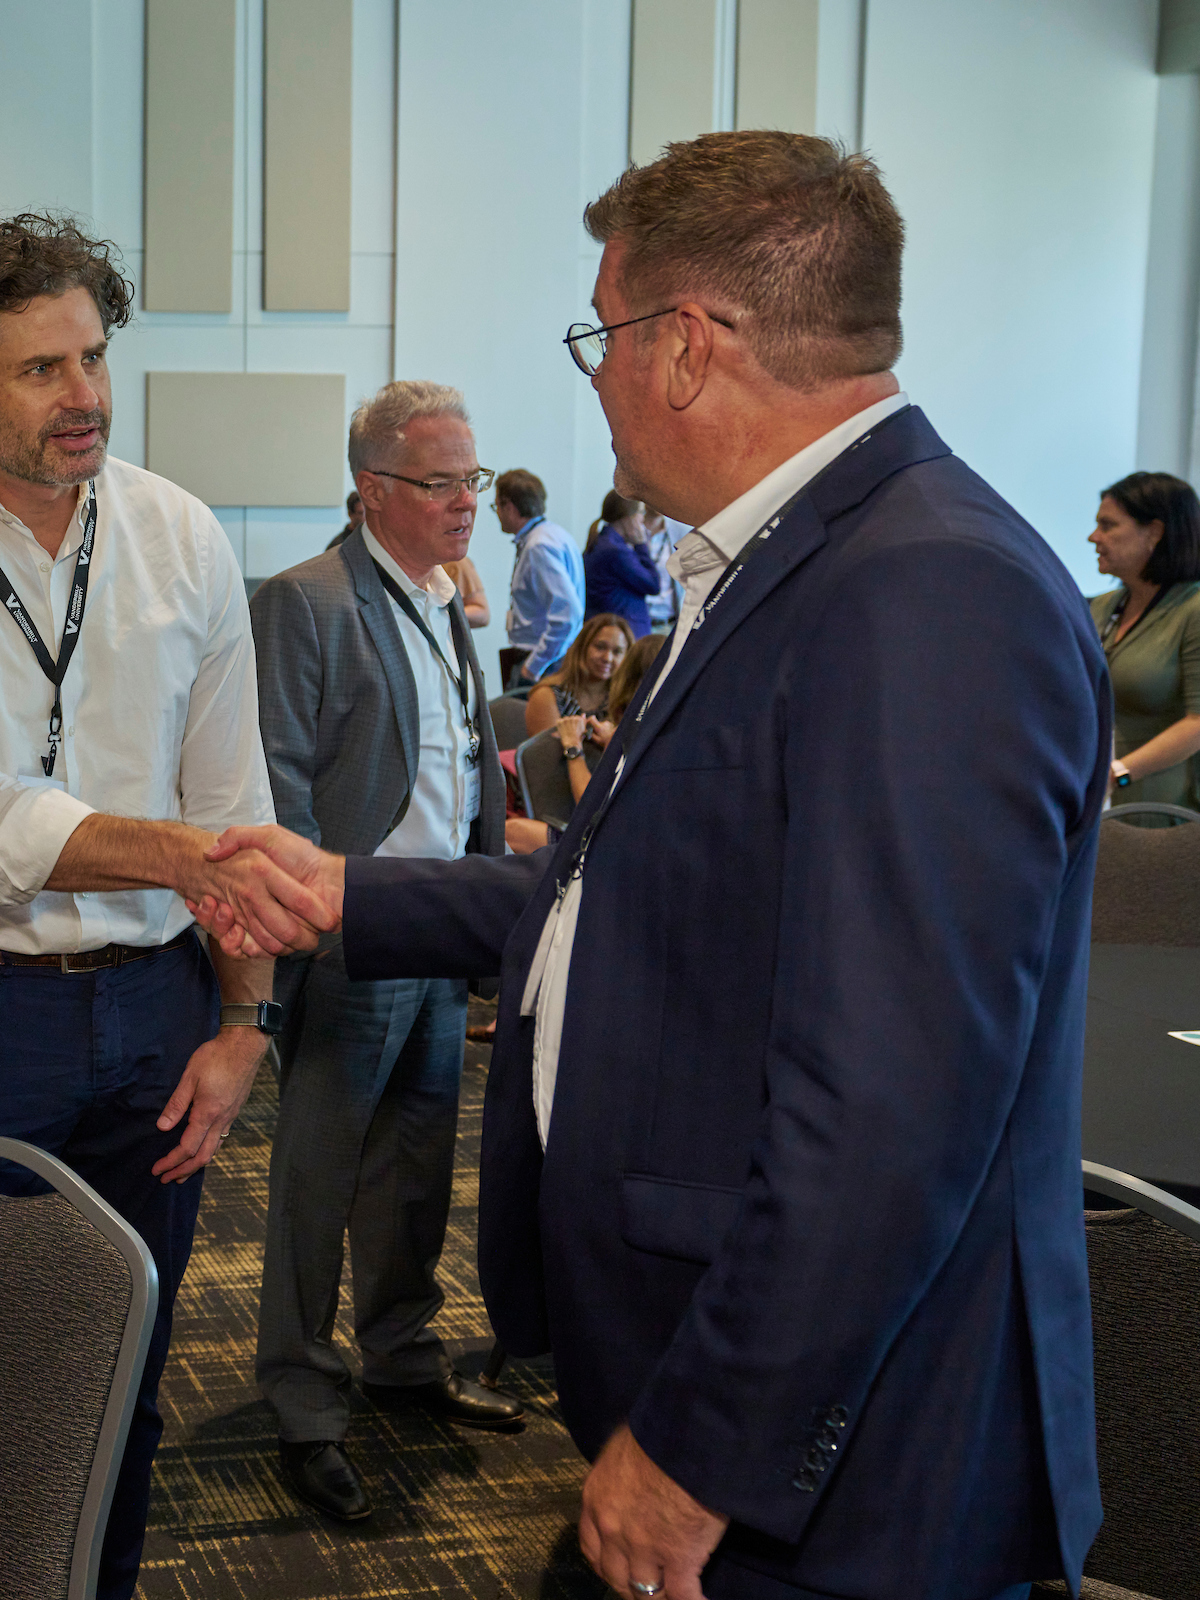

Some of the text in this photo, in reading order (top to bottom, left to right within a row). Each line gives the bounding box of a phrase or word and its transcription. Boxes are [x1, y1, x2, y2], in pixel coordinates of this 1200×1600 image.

[82, 517, 94, 551] VANDERBILT
[78, 549, 90, 566] V
[5, 592, 21, 608] V
[70, 584, 80, 620] VANDERBILT
[75, 587, 84, 621] UNIVERSITY
[13, 610, 35, 643] UNIVERSITY
[17, 608, 39, 643] VANDERBILT
[65, 618, 78, 635] V
